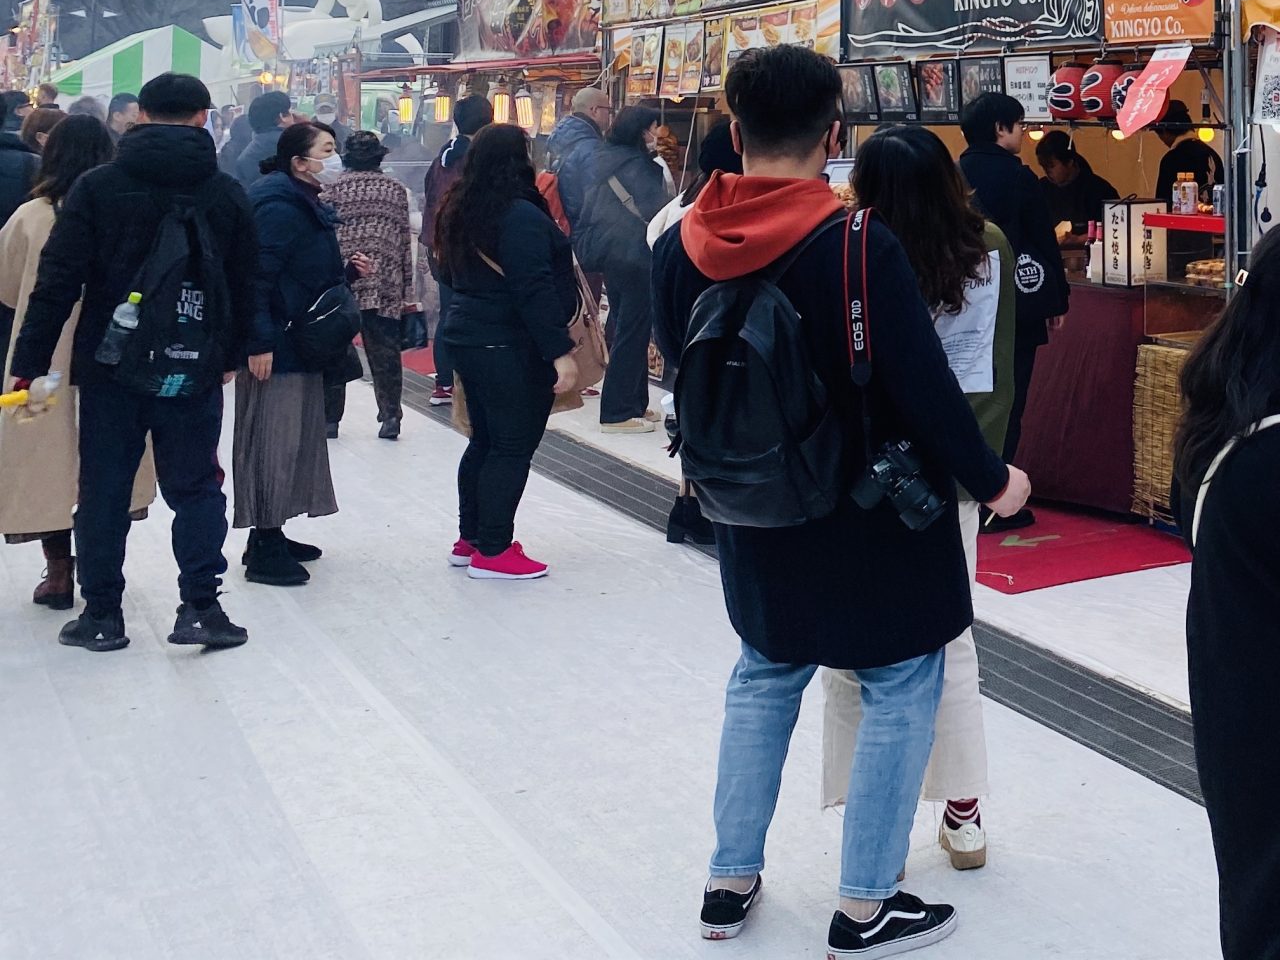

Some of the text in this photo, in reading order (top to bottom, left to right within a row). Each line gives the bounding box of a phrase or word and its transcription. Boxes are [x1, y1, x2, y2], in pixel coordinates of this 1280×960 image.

[1110, 15, 1185, 39] KINGYO Co.
[1111, 212, 1119, 269] たこ焼き
[851, 299, 862, 319] 70D
[852, 321, 864, 351] EOS
